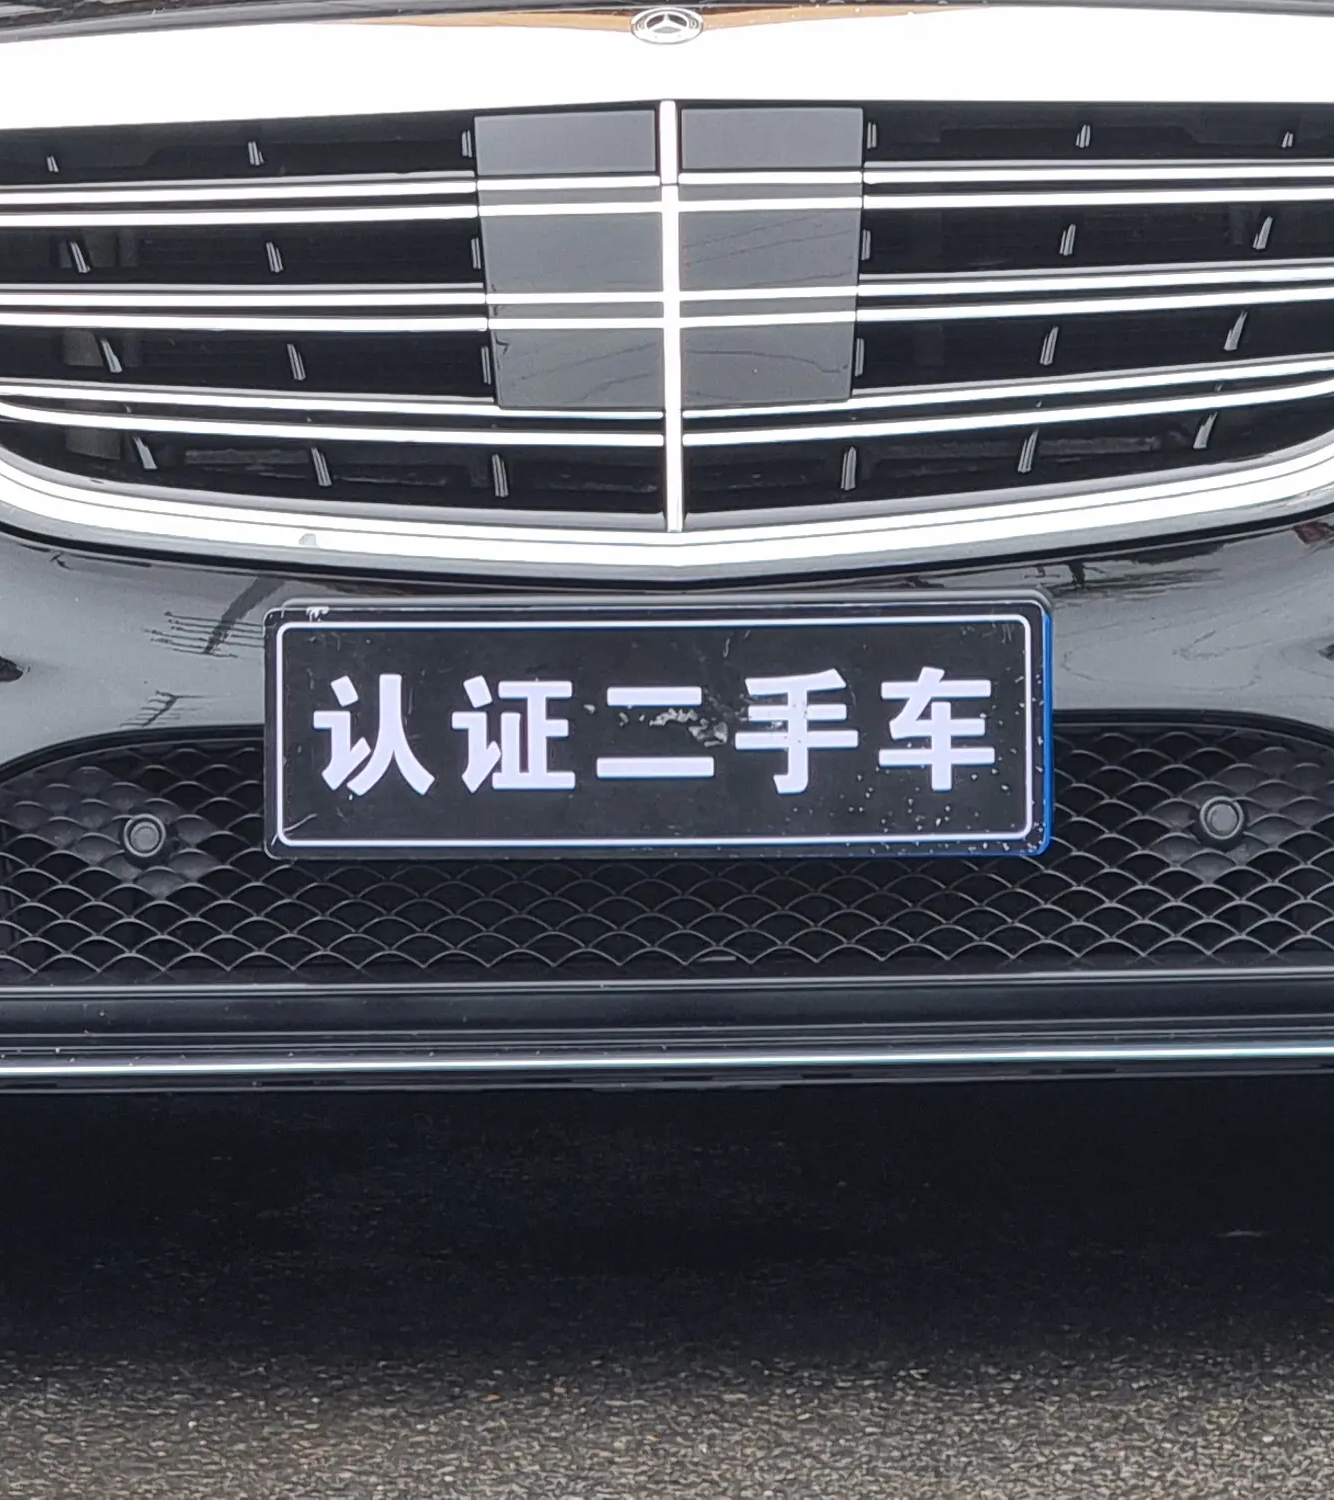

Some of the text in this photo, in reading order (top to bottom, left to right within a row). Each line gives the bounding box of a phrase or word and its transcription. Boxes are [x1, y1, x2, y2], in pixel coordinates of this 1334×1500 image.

[312, 667, 996, 796] 认证二手车
